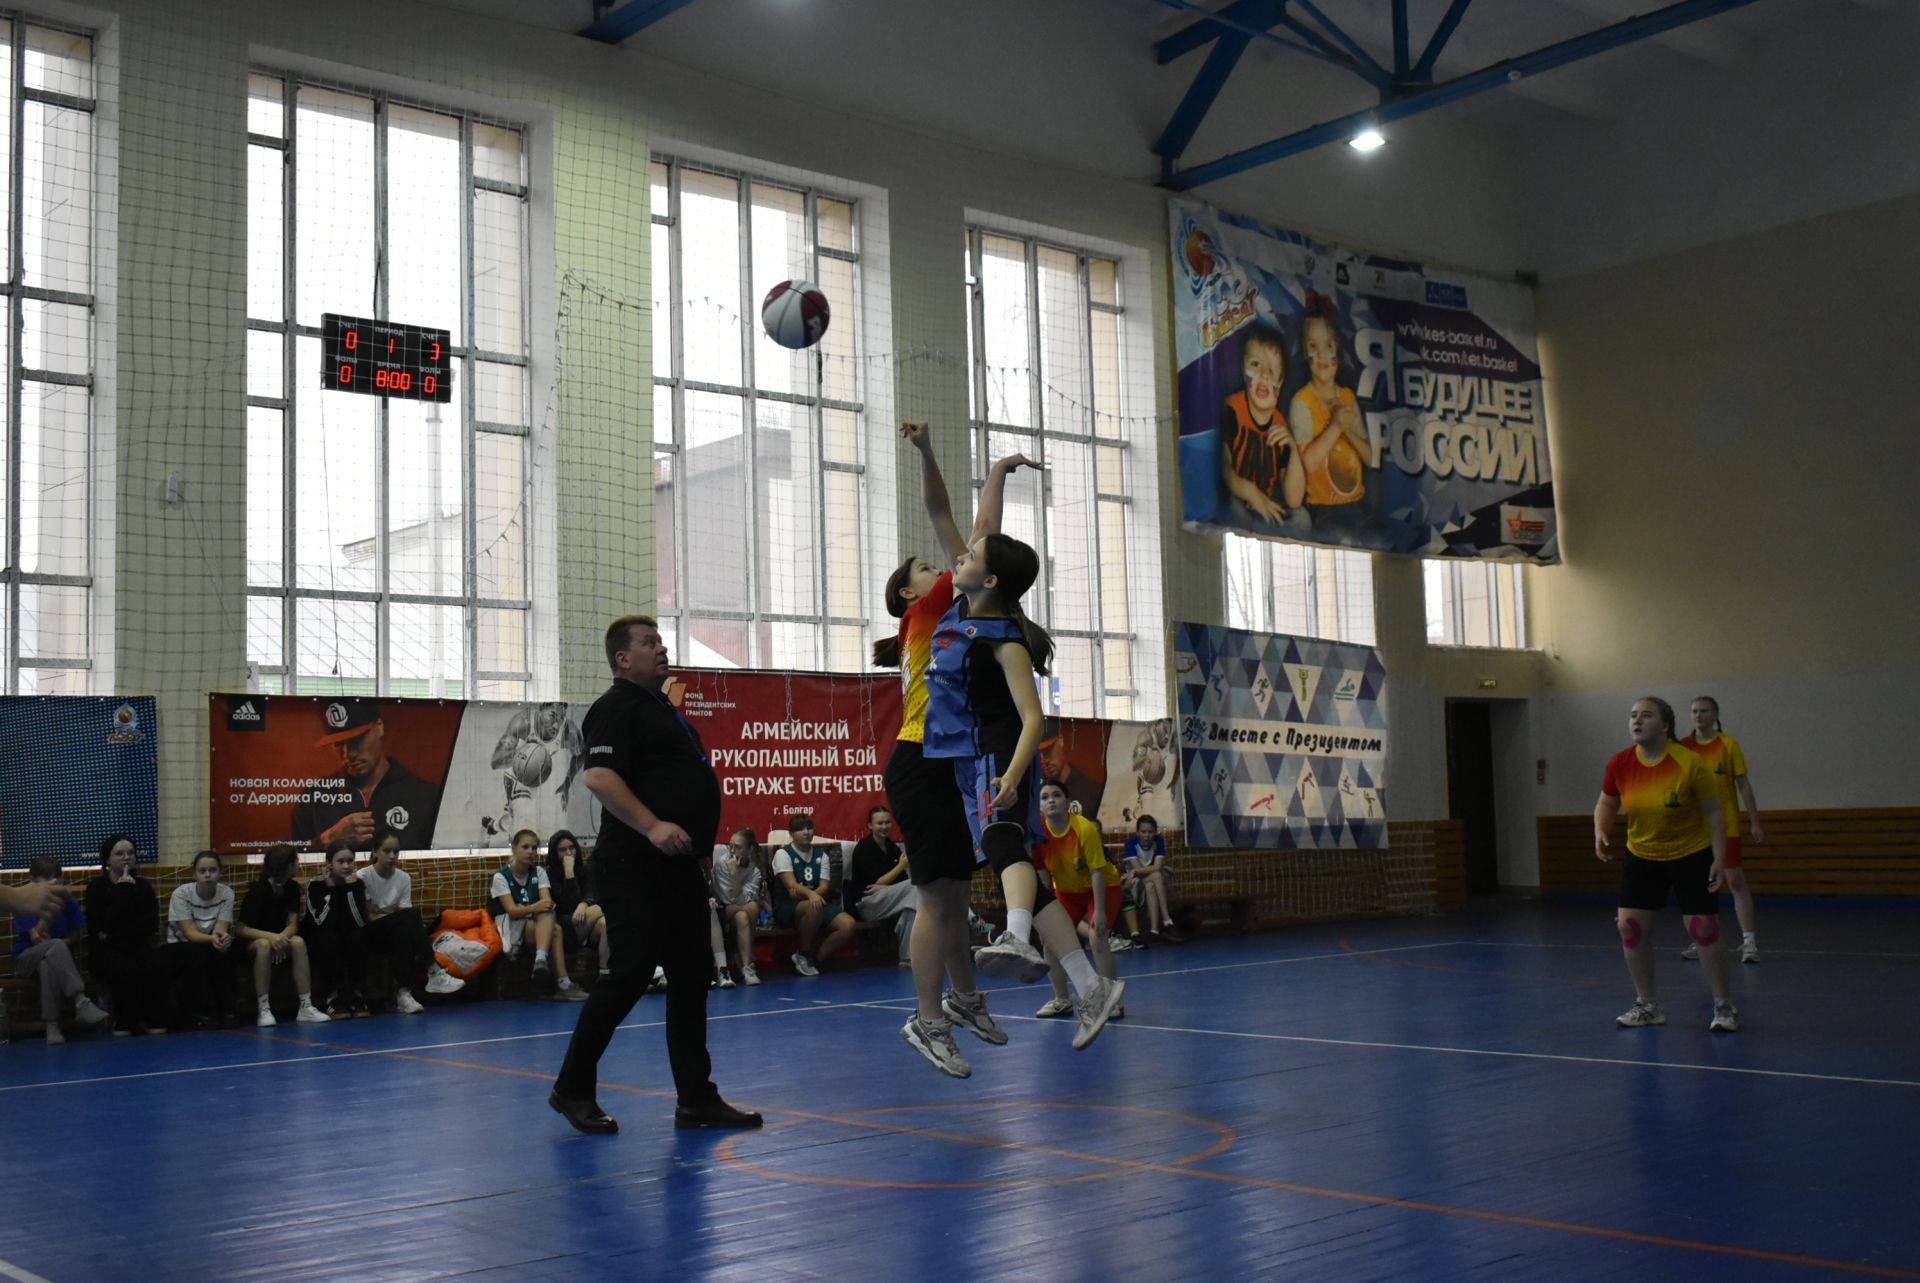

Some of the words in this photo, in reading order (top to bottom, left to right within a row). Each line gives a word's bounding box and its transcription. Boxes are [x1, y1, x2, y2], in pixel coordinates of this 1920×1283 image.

[345, 331, 358, 350] 0
[374, 327, 404, 337] ПЕРИОД
[388, 338, 395, 354] 1
[430, 343, 441, 361] 3
[377, 361, 401, 369] ВРЕМЯ
[1354, 328, 1397, 403] Я
[339, 365, 352, 383] 0
[375, 370, 411, 391] 8:00
[424, 376, 436, 393] 0
[1366, 411, 1539, 487] РОССИИ
[684, 692, 704, 700] ФОНД
[684, 701, 736, 709] ПРЕЗИДЕНТСКИХ
[685, 709, 713, 717] ГРАНТОВ
[741, 718, 850, 740] АРМЕЙСКИЙ
[1209, 723, 1268, 745] Вместе
[1273, 731, 1280, 744] с
[1286, 727, 1381, 753] Президентом
[711, 745, 839, 768] РУКОПАШНЫЙ
[844, 744, 877, 766] БОЙ
[229, 778, 270, 788] новая
[272, 778, 346, 789] коллекция
[723, 776, 795, 796] СТРАЖЕ
[801, 774, 886, 794] ОТЕЧЕСТВ
[229, 793, 245, 803] от
[247, 791, 311, 806] Деррика
[313, 791, 353, 806] Роуза
[773, 807, 781, 815] г.
[783, 805, 814, 816] Болгар
[803, 866, 813, 882] 8
